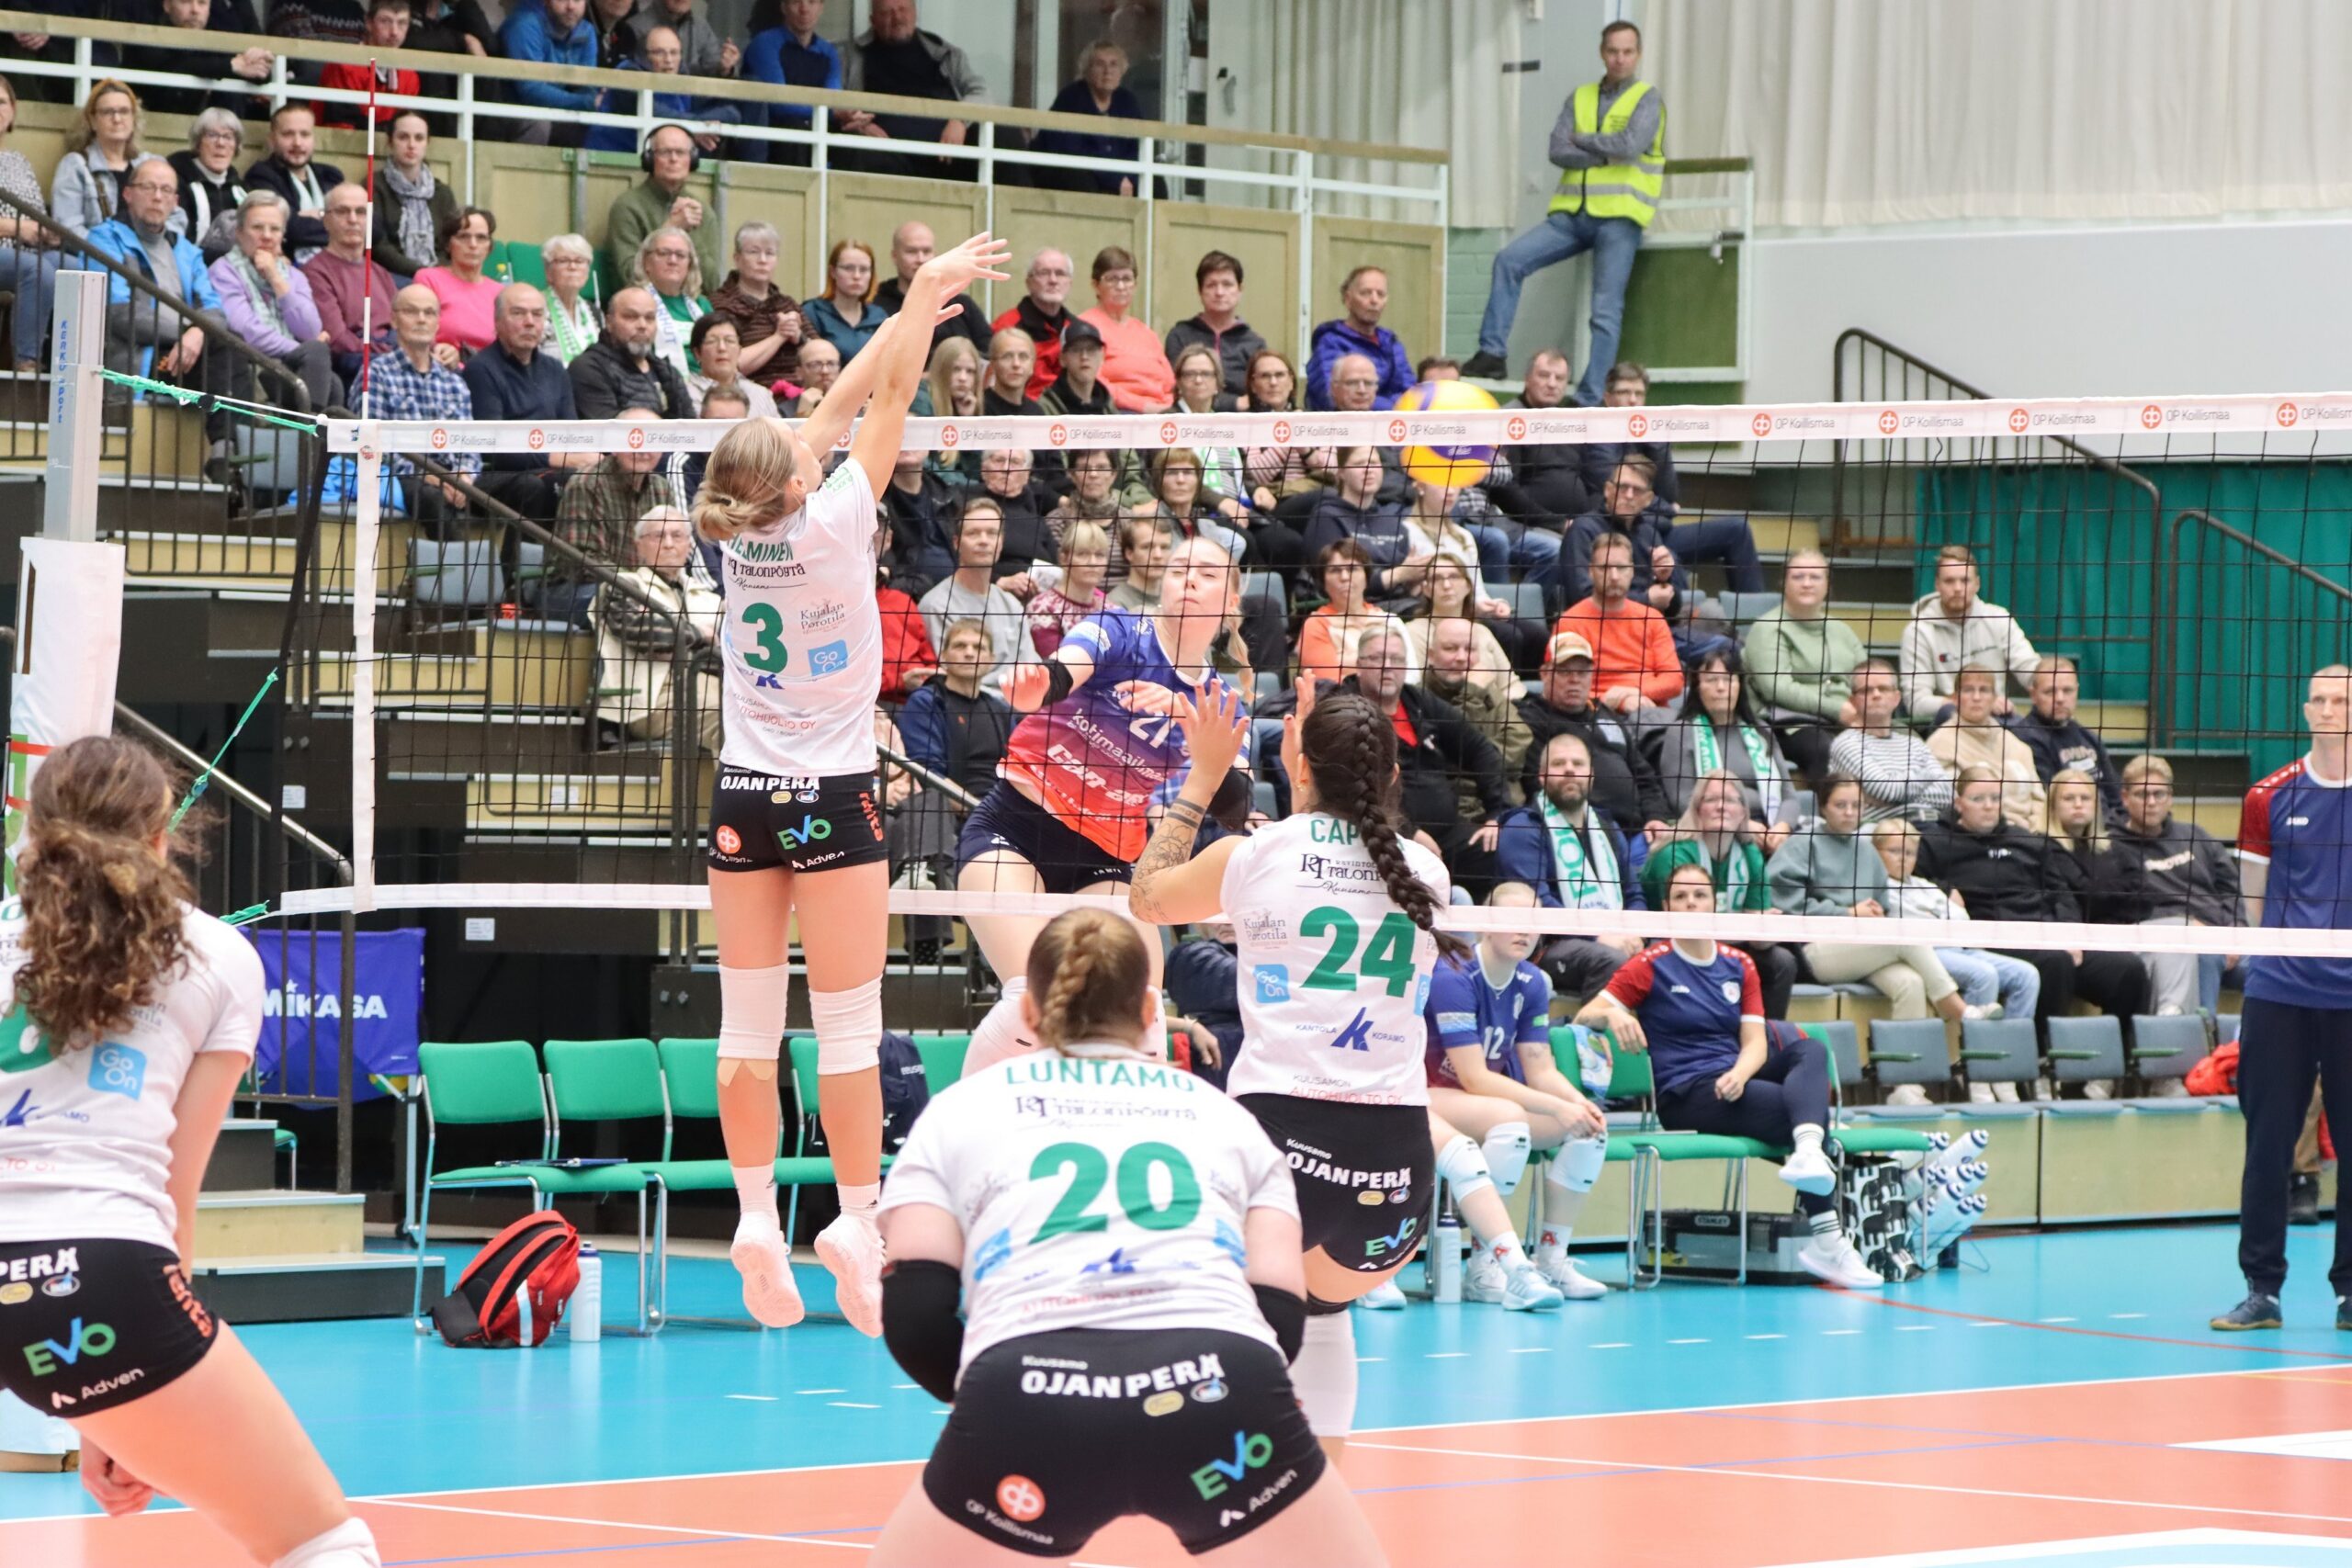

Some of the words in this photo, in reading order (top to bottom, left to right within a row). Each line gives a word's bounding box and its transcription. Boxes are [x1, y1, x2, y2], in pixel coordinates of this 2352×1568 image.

[2032, 413, 2046, 426] OP
[2047, 413, 2096, 426] Koillismaa
[2165, 409, 2179, 422] OP
[2181, 409, 2230, 422] Koillismaa
[2301, 407, 2315, 420] OP
[2317, 407, 2352, 420] Koillism
[1529, 423, 1541, 434] OP
[1543, 423, 1587, 434] Koillismaa
[1651, 419, 1663, 432] OP
[1666, 419, 1710, 432] Koillismaa
[1775, 418, 1788, 430] OP
[1790, 418, 1836, 430] Koillismaa
[1902, 416, 1915, 428] OP
[1917, 416, 1963, 428] Koillismaa
[961, 429, 972, 441] OP
[973, 429, 1012, 441] Koillismaa
[1069, 428, 1080, 440] OP
[1081, 428, 1122, 440] Koillismaa
[1180, 427, 1192, 440] OP
[1193, 427, 1235, 440] Koillismaa
[1294, 425, 1305, 437] OP
[1306, 425, 1349, 437] Koillismaa
[1409, 424, 1421, 435] OP
[1423, 424, 1465, 435] Koillismaa
[449, 434, 459, 446] OP
[460, 434, 496, 446] Koillismaa
[546, 434, 556, 445] OP
[558, 434, 594, 445] Koillismaa
[646, 434, 657, 445] OP
[659, 434, 695, 445] Koillismaa
[800, 603, 845, 620] Kujalan
[801, 612, 845, 630] Porotila
[741, 602, 788, 673] 3
[776, 814, 832, 851] EVO
[1243, 915, 1286, 931] Kujalan
[1247, 928, 1287, 942] Porotila
[1298, 906, 1416, 998] 24
[1295, 1022, 1338, 1034] KANTOLA
[1484, 1025, 1505, 1060] 12
[99, 1049, 134, 1071] Go
[105, 1066, 138, 1091] On
[1028, 1141, 1203, 1247] 20
[1365, 1217, 1418, 1257] EVO
[22, 1316, 117, 1377] EVO
[1022, 1355, 1088, 1371] Kuusamo
[81, 1368, 145, 1399] Adven
[1190, 1430, 1273, 1501] EVO
[1249, 1468, 1298, 1513] Adven
